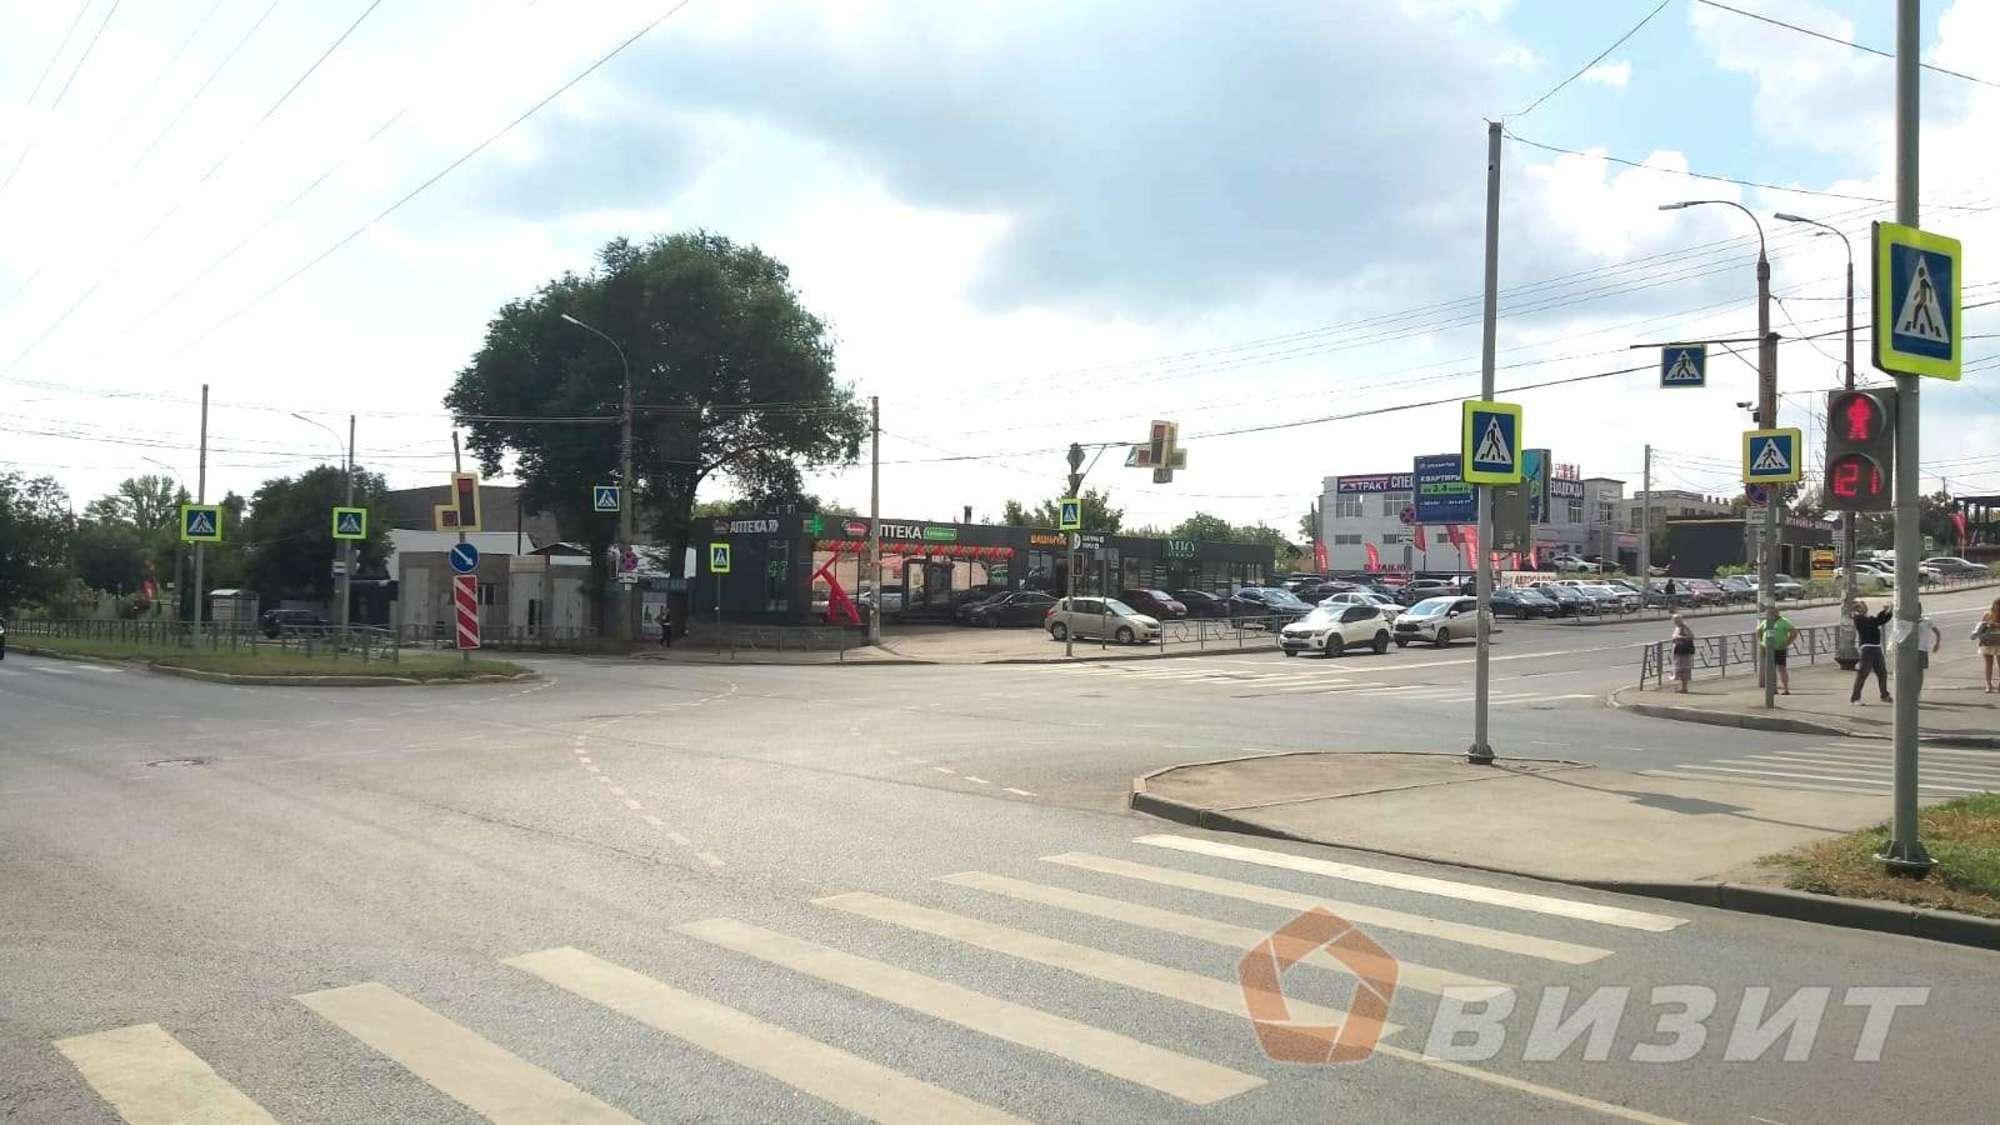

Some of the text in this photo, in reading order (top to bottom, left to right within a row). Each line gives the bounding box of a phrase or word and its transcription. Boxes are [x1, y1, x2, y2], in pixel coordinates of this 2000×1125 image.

[1833, 463, 1882, 497] 21
[729, 519, 768, 534] АПТЕКА
[869, 523, 922, 540] ПТЕКА
